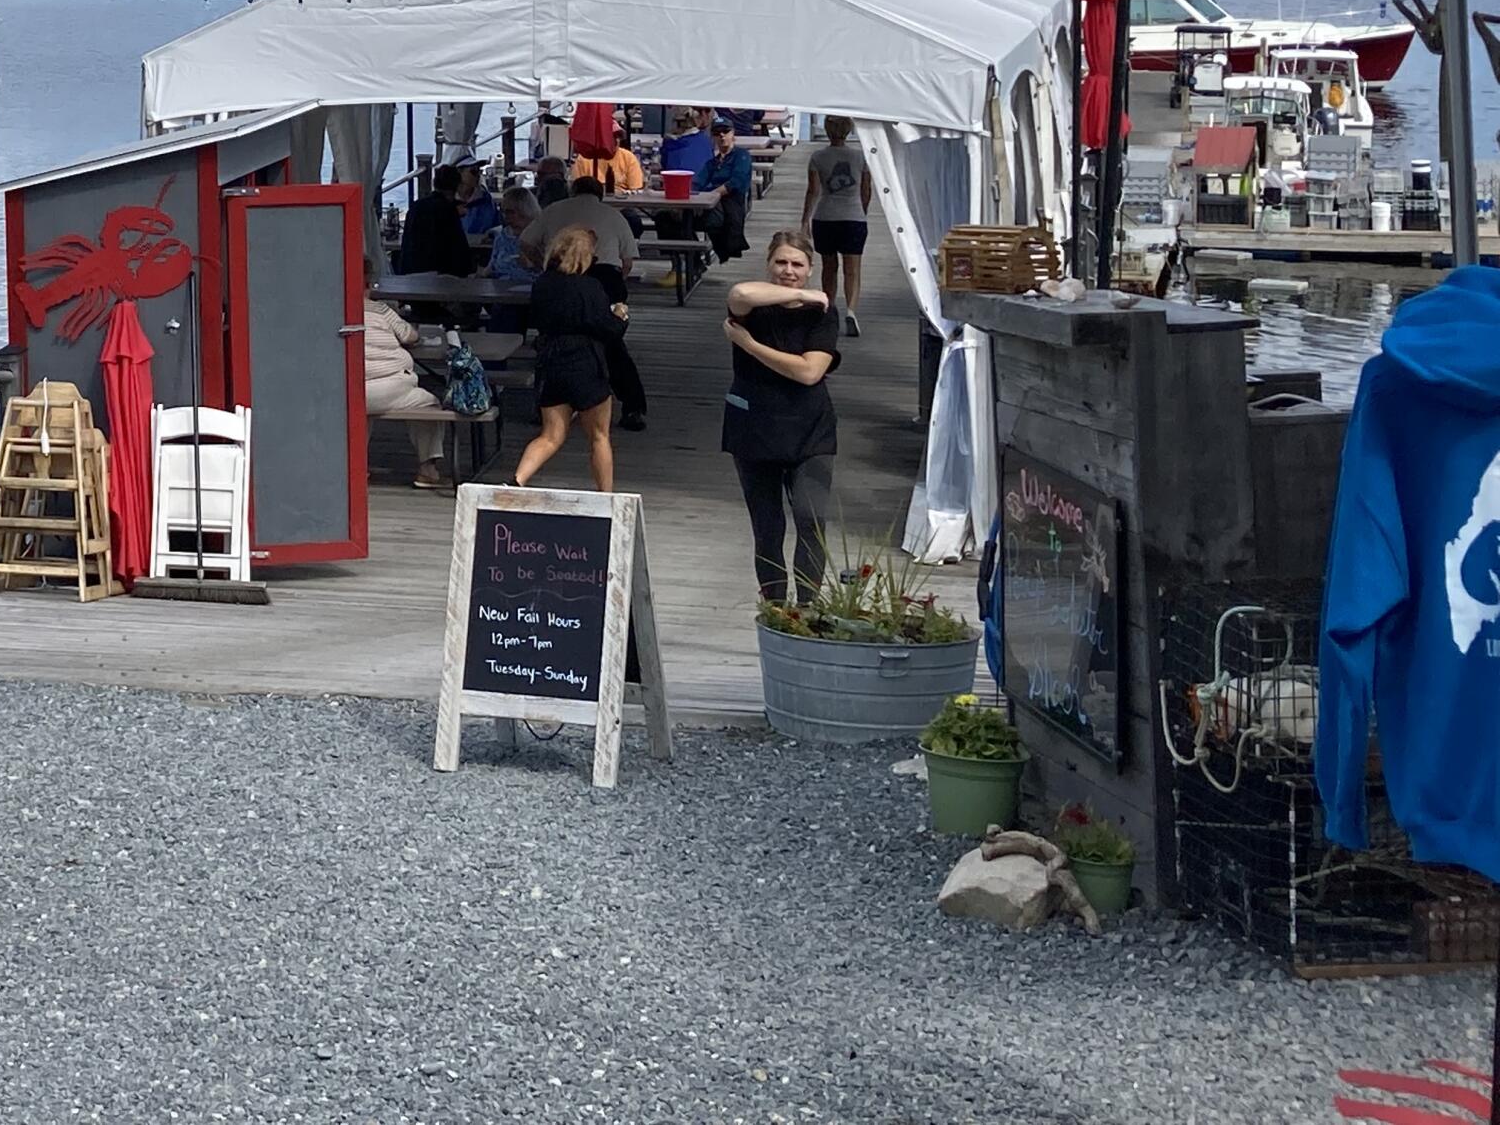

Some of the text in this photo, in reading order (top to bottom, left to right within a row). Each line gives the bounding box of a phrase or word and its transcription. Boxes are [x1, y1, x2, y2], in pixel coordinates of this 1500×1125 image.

[1020, 468, 1084, 533] Welcome
[493, 522, 589, 562] Please Wait
[487, 566, 505, 583] To
[517, 565, 536, 581] be
[479, 605, 582, 630] New Fall Hours
